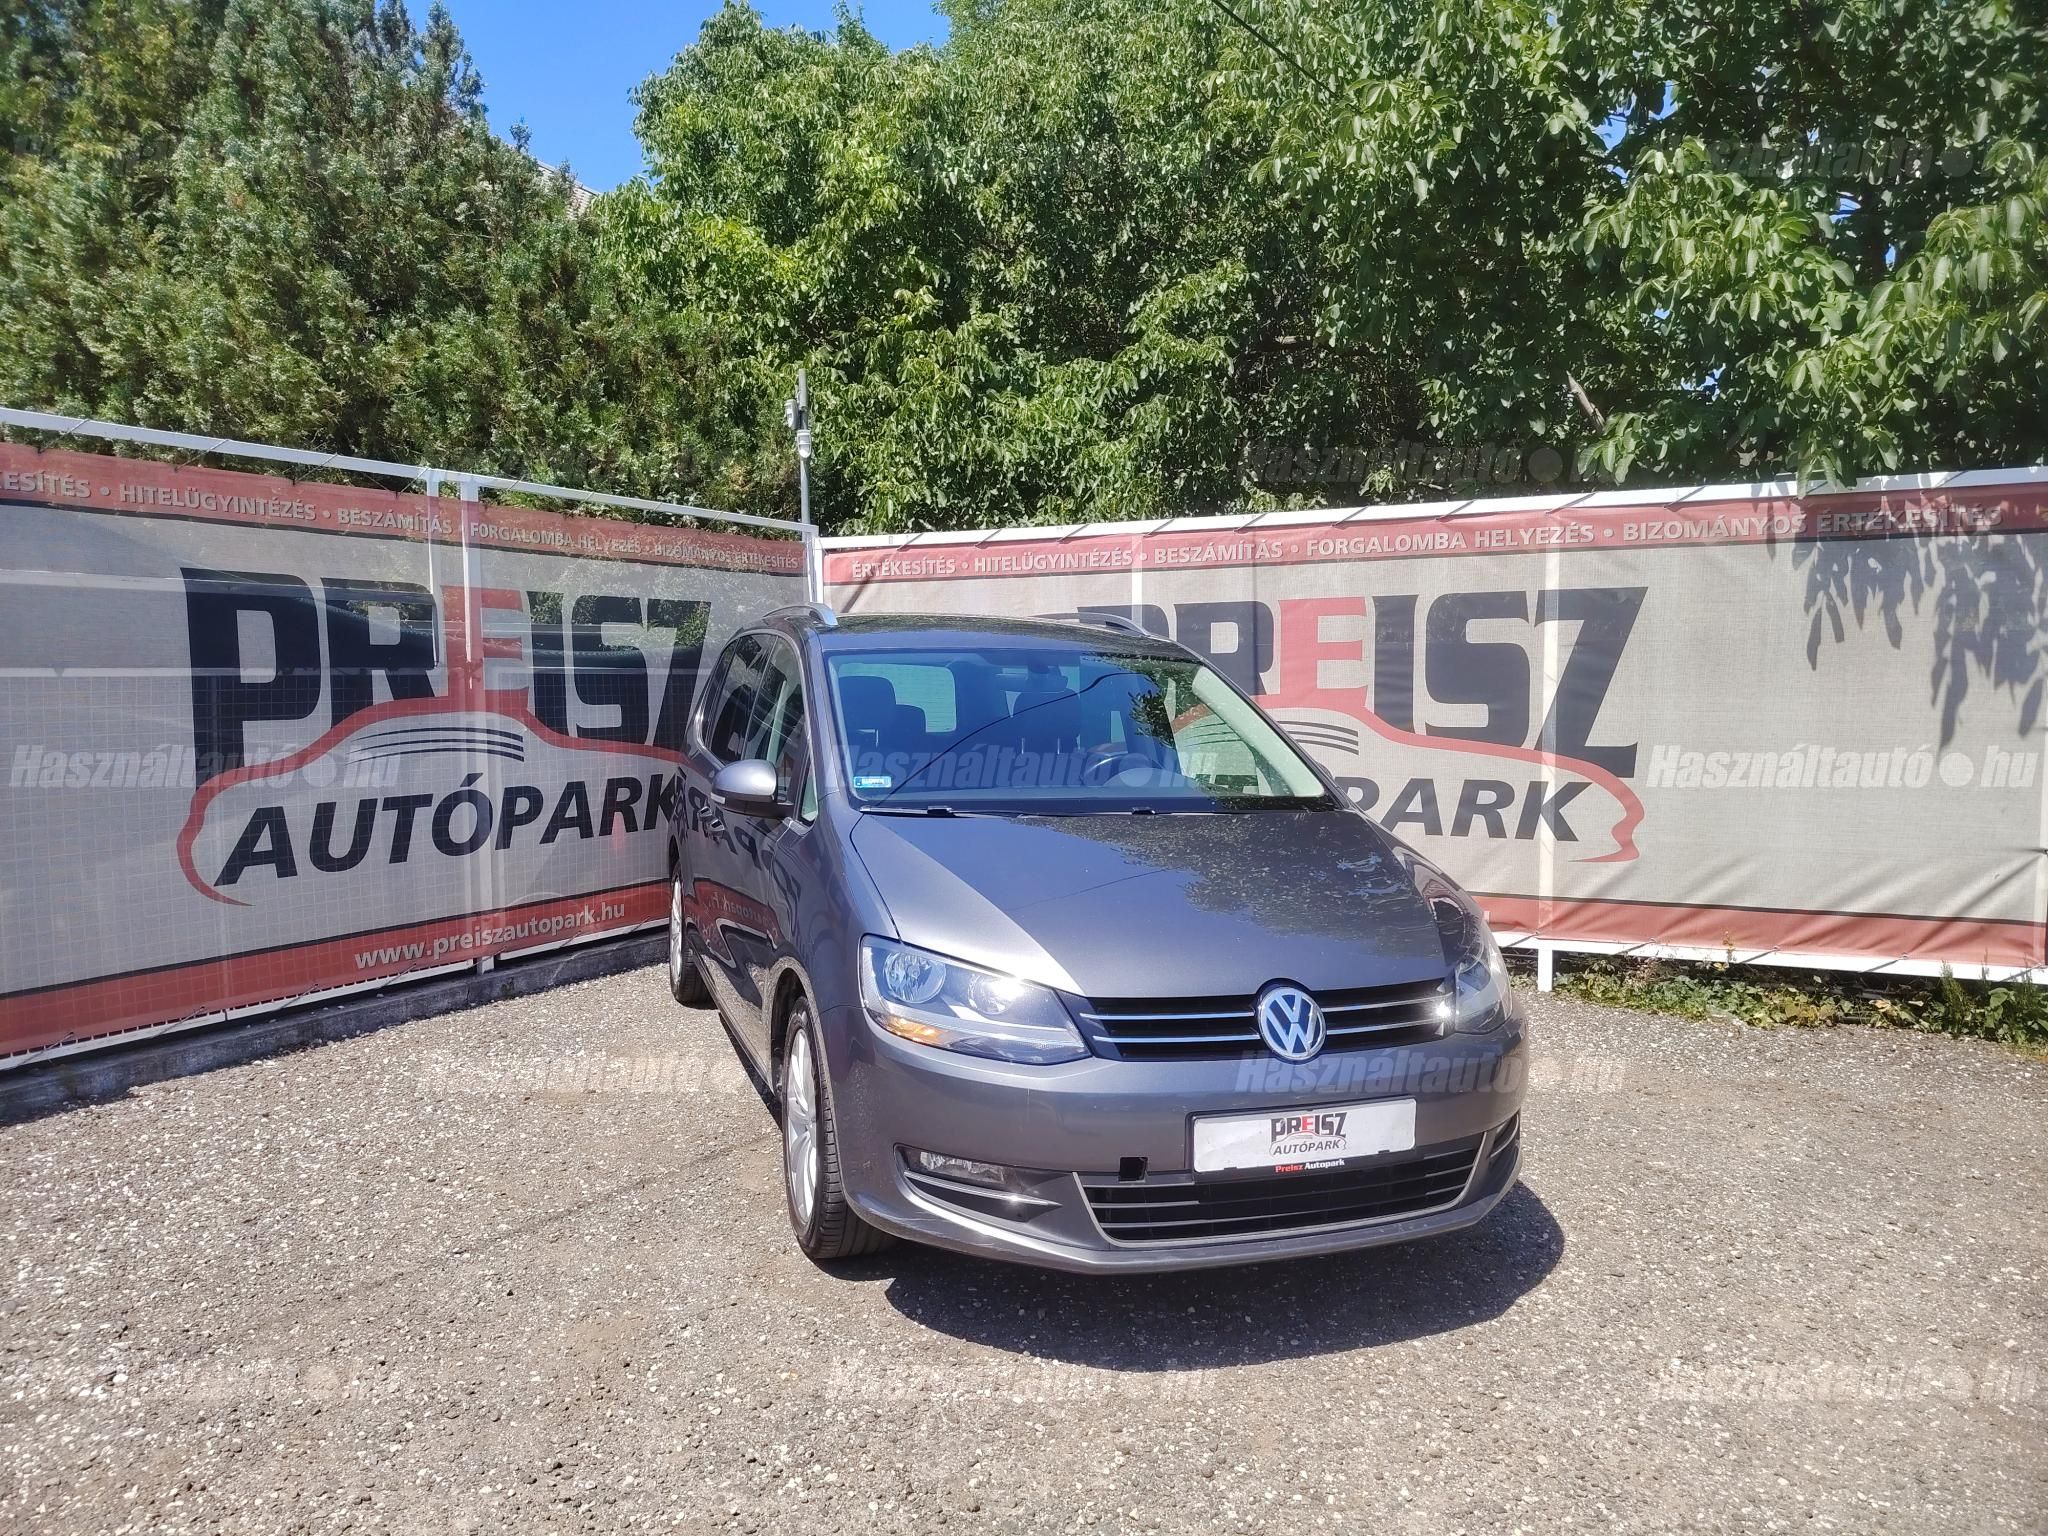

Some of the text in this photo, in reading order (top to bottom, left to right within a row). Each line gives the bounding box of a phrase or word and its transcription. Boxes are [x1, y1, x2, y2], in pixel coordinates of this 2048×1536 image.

[0, 470, 91, 498] ESÍTÉS
[120, 483, 317, 521] HITELÜGYINTÉZÉS
[337, 507, 453, 535] BESZÁMÍTÁS
[470, 522, 575, 549] FORGALOMBA
[852, 556, 956, 579] ÉRTÉKESÍTÉS
[974, 548, 1133, 573] HITELÜGYINTÉZÉS
[1154, 538, 1283, 565] BESZÁMÍTÁS
[1306, 531, 1467, 557] FORGALOMBA
[1474, 521, 1594, 548] HELYEZÉS
[1622, 513, 1807, 542] BIZOMÁNYOS
[1078, 587, 1648, 778] REISZ
[213, 773, 678, 887] AUTÓPARK
[1334, 776, 1593, 842] PARK
[354, 901, 626, 970] www.preiszautopark.hu
[1270, 1111, 1348, 1144] PREISZ
[1273, 1138, 1341, 1156] AUTÓPARK
[1275, 1158, 1345, 1173] Preisz Autopark
